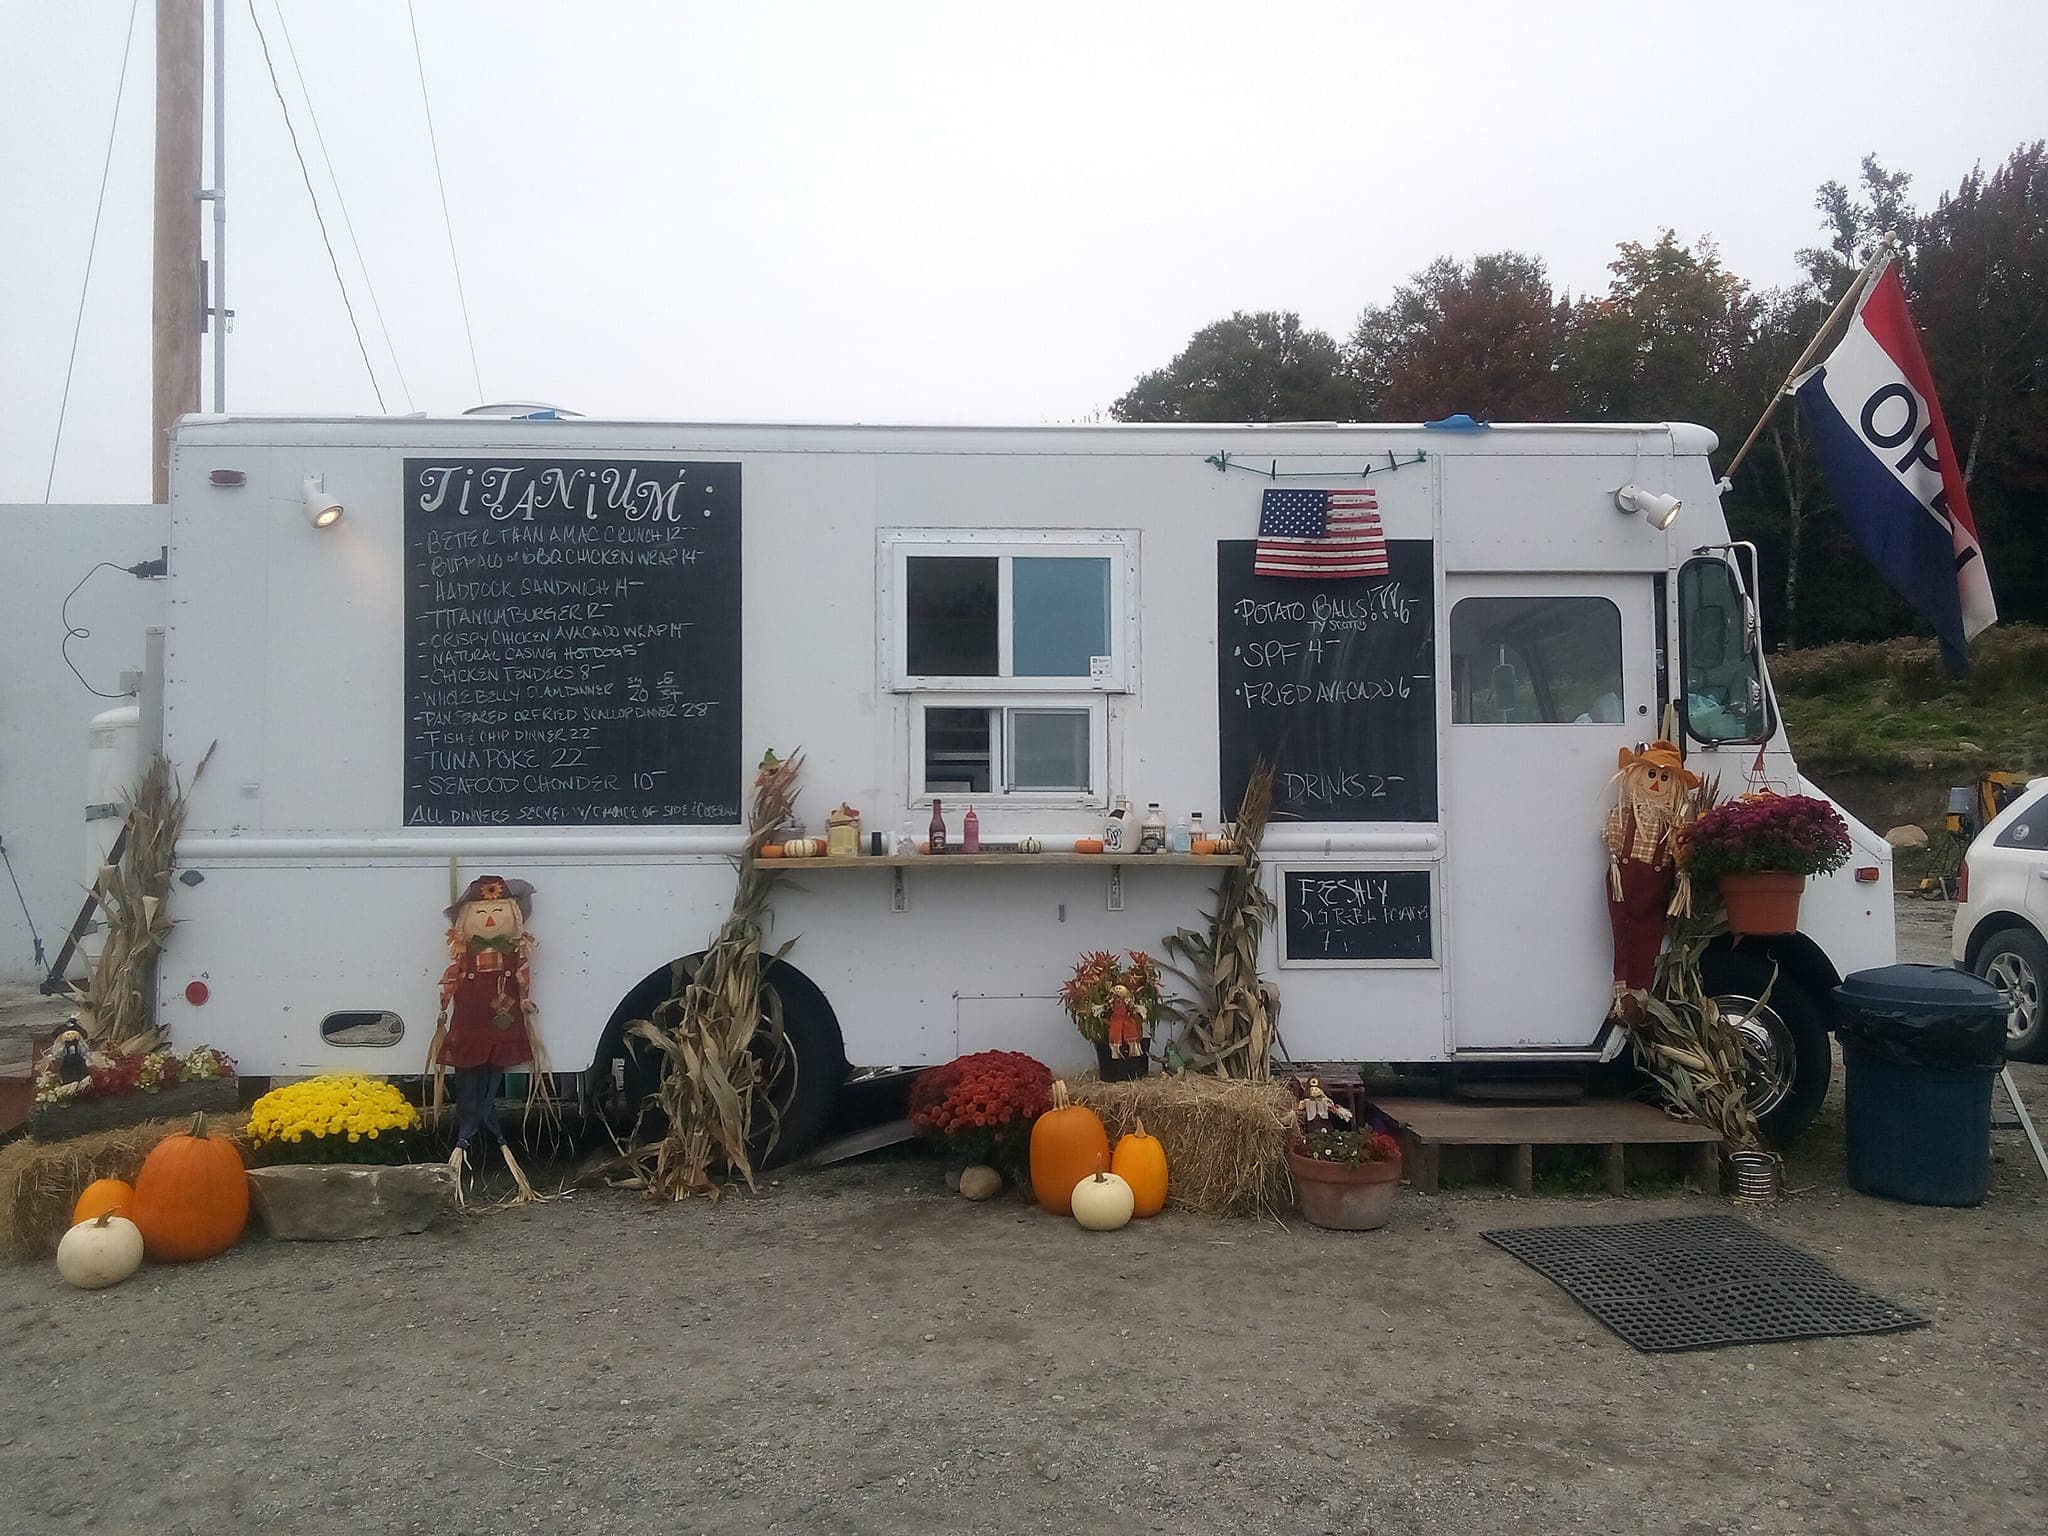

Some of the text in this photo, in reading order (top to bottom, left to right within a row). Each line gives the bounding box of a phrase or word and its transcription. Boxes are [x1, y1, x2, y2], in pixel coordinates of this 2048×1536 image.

[1860, 382, 1978, 573] OP
[427, 528, 497, 554] BETTER
[500, 526, 544, 544] THAN
[550, 526, 562, 542] A
[564, 525, 600, 544] MAC
[604, 525, 662, 544] CRUNCH
[431, 552, 503, 577] BUFFALO
[566, 548, 634, 565] CHICKEN
[637, 548, 678, 566] WRAP
[435, 580, 516, 601] HADDOCK
[521, 577, 609, 597] SANDWICH
[425, 607, 510, 630] TITANIUM
[507, 603, 584, 624] BURGER
[1236, 599, 1306, 625] POTATO
[431, 632, 489, 648] CRISPY
[492, 627, 550, 645] CHICKEN
[624, 624, 668, 638] WRAP
[433, 648, 501, 668] NATURAL
[505, 648, 557, 661] CASING
[1243, 640, 1301, 667] SPF
[430, 667, 500, 685] CHICKEN
[502, 665, 574, 682] TENDERS
[423, 689, 473, 706] WHOLE
[474, 688, 521, 704] BELLY
[565, 683, 615, 697] DINNER
[1243, 681, 1312, 708] FRIED
[419, 711, 451, 727] PAN
[455, 709, 508, 725] SEARED
[531, 707, 578, 722] FRIED
[583, 706, 634, 721] SCALLOP
[635, 704, 678, 719] DINNER
[423, 730, 464, 747] FISH
[479, 729, 510, 742] CHIP
[515, 728, 568, 743] DINNER
[424, 750, 481, 770] TUNA
[483, 748, 540, 770] POKE
[428, 775, 520, 796] SEAFOOD
[1284, 766, 1366, 804] DRINKS
[408, 804, 444, 825] ALL
[450, 808, 511, 824] DINNERS
[662, 803, 688, 817] SIDE
[1297, 877, 1388, 907] FRESHLY
